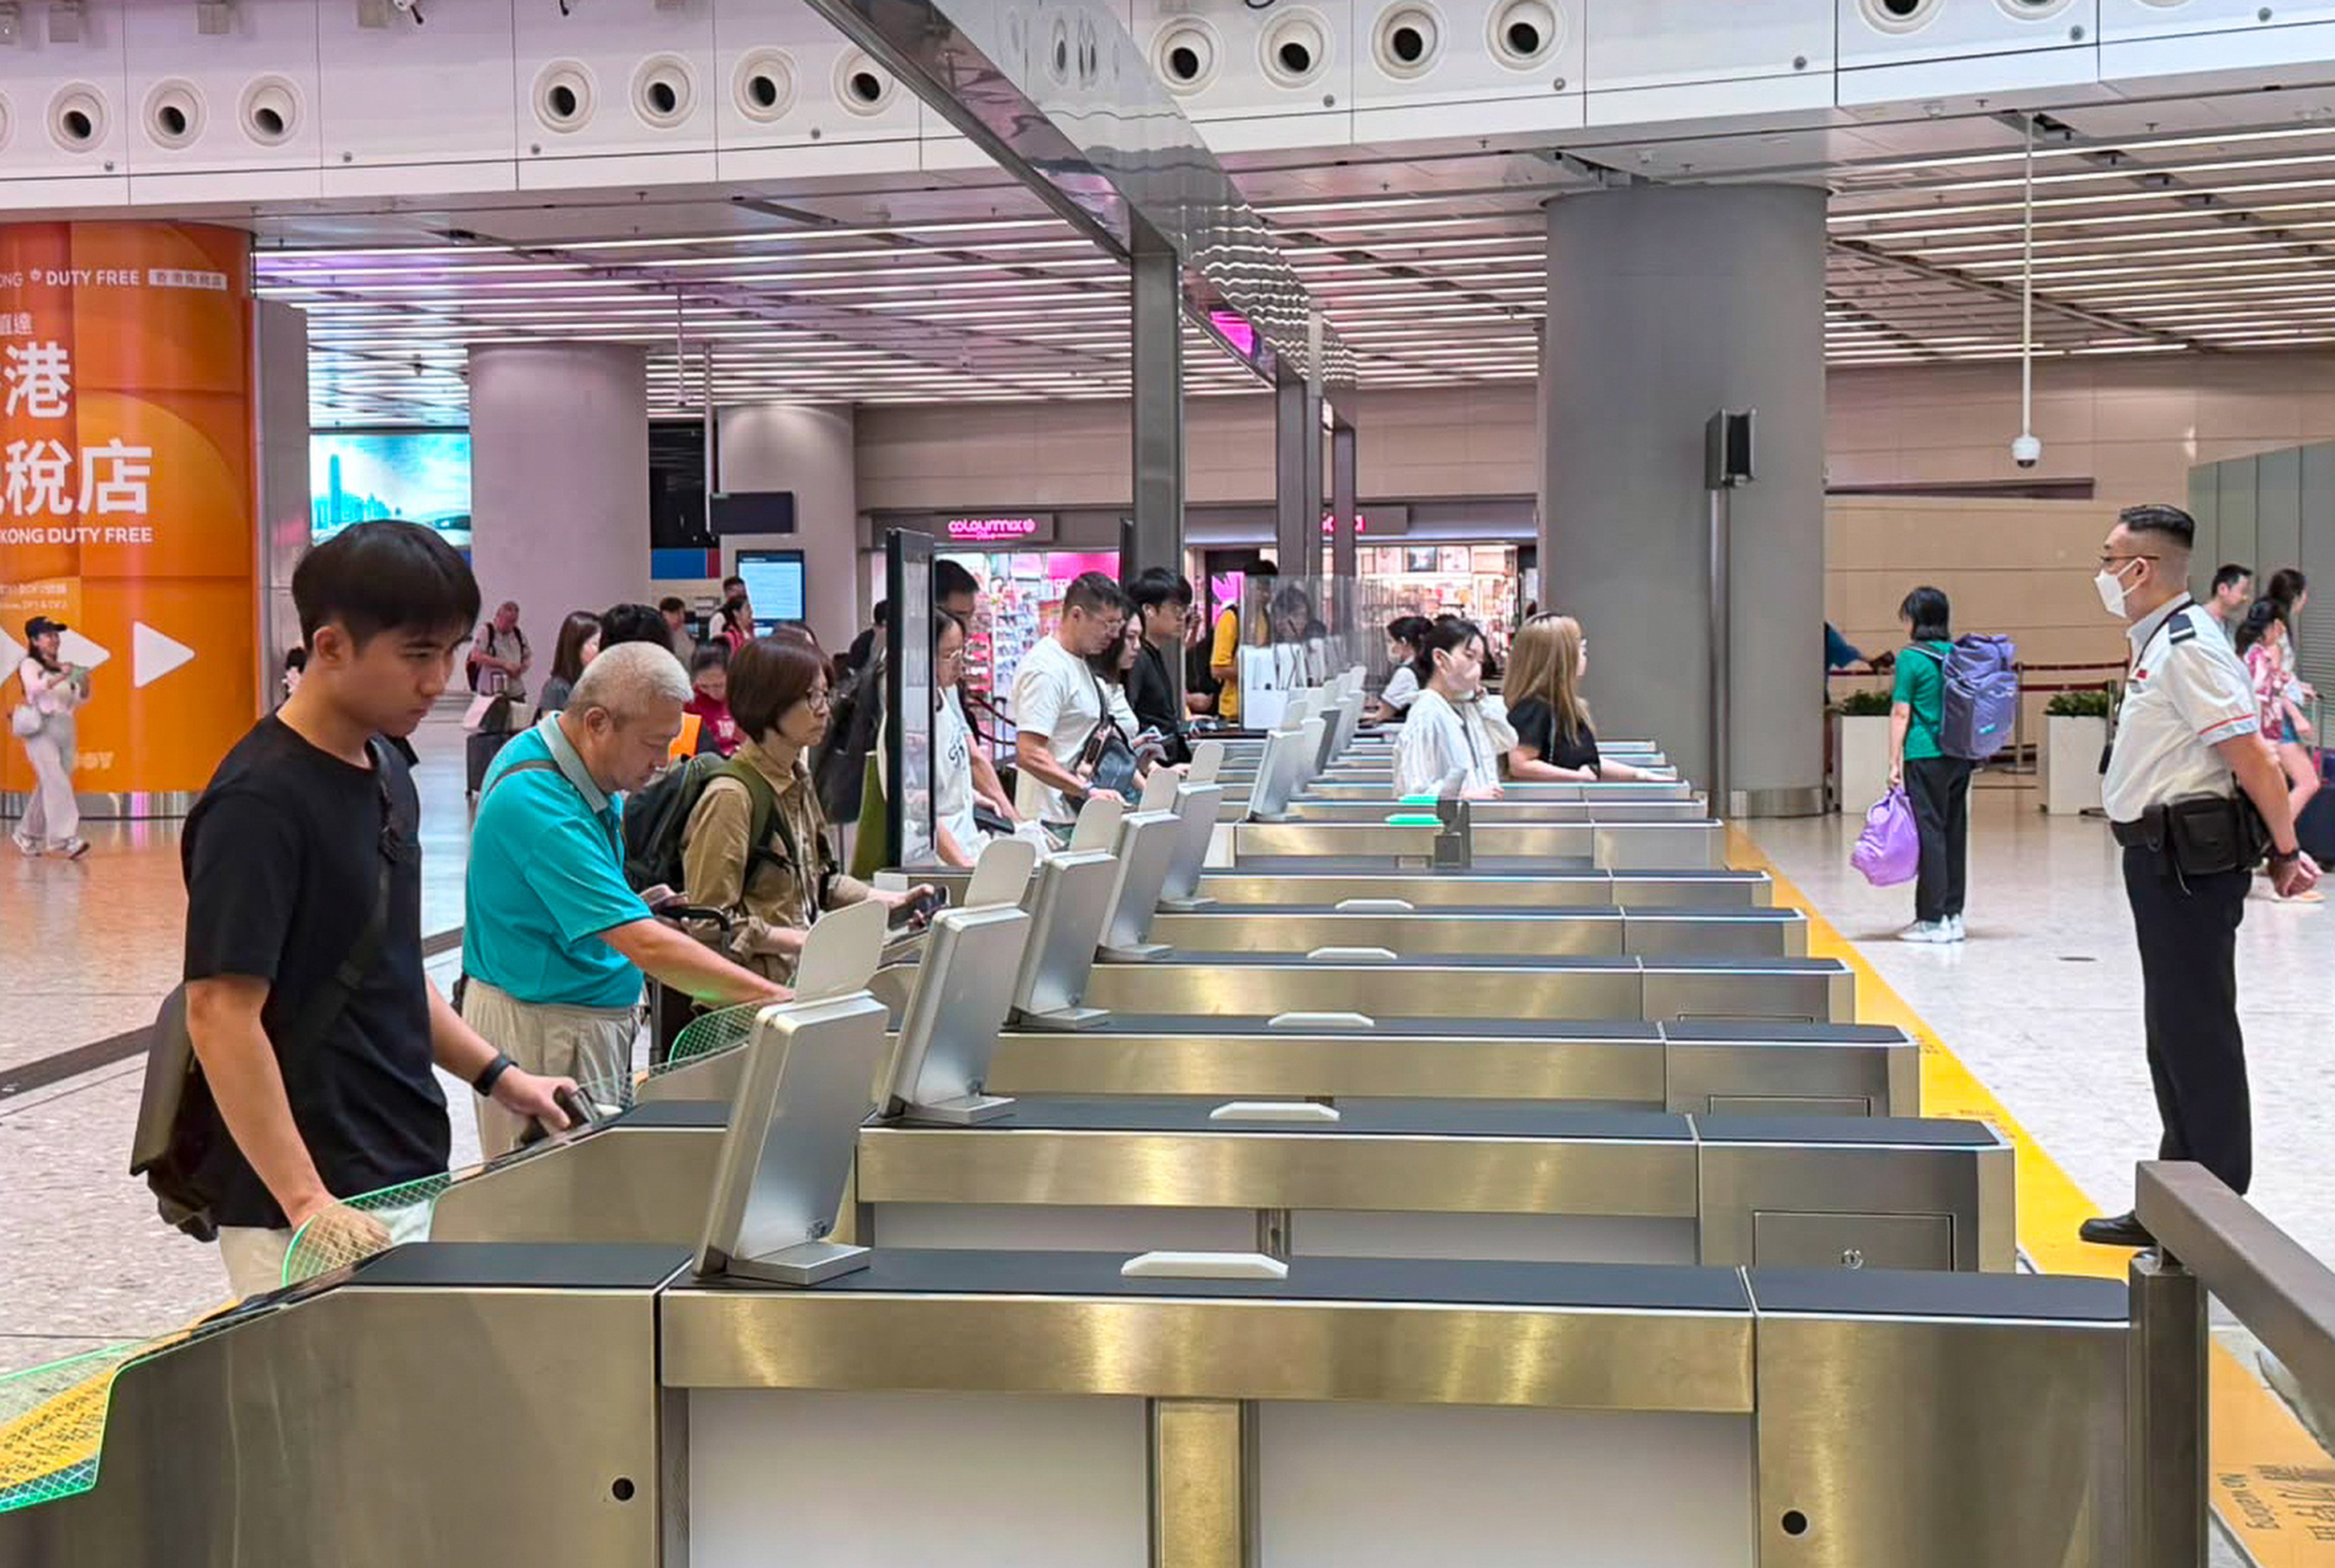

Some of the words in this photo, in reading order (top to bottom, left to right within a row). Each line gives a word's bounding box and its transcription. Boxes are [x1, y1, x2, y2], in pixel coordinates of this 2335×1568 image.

[46, 270, 91, 286] DUTY
[96, 270, 140, 284] FREE
[0, 437, 152, 515] 稅店
[48, 527, 101, 543] DUTY
[105, 527, 153, 542] FREE
